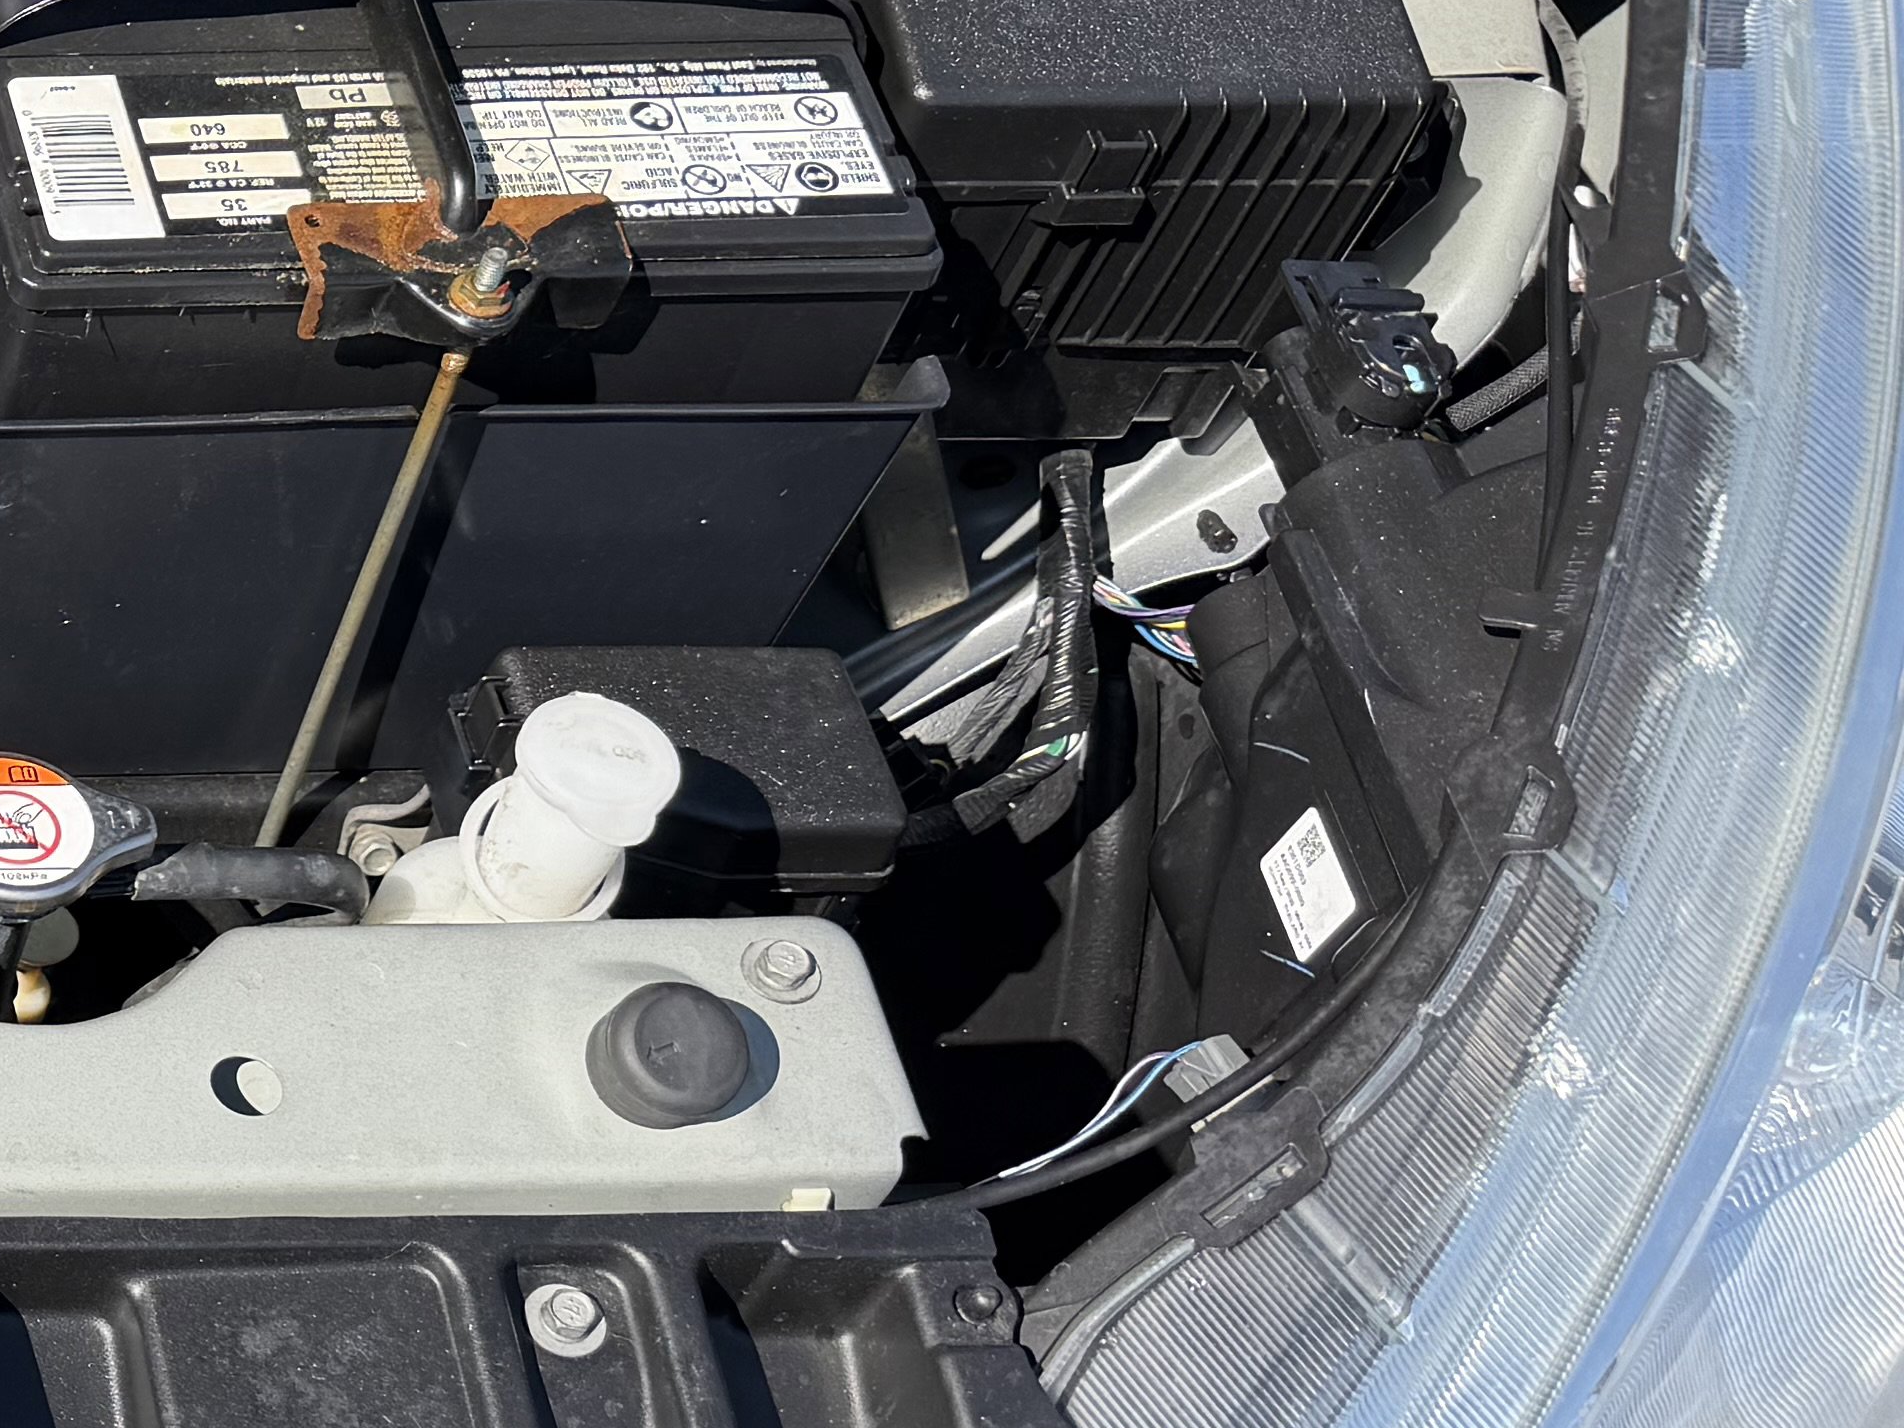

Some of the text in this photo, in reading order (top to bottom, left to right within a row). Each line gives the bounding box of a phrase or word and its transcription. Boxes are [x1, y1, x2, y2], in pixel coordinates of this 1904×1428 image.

[733, 60, 753, 70] East
[328, 88, 367, 104] Pb
[501, 110, 523, 119] NOT
[526, 109, 540, 117] DO
[190, 123, 225, 136] 640
[508, 120, 529, 128] NOT
[767, 148, 869, 160] EXPLOSIVE GASES
[204, 160, 244, 173] 785
[527, 172, 556, 183] WITH
[645, 167, 672, 178] ACID
[726, 173, 742, 183] NO
[841, 172, 881, 183] SHIELD
[229, 179, 247, 187] CA
[483, 183, 562, 194] IMMEDIATELY
[620, 178, 678, 190] SULFURIC
[220, 198, 248, 211] 35
[241, 216, 272, 224] PART
